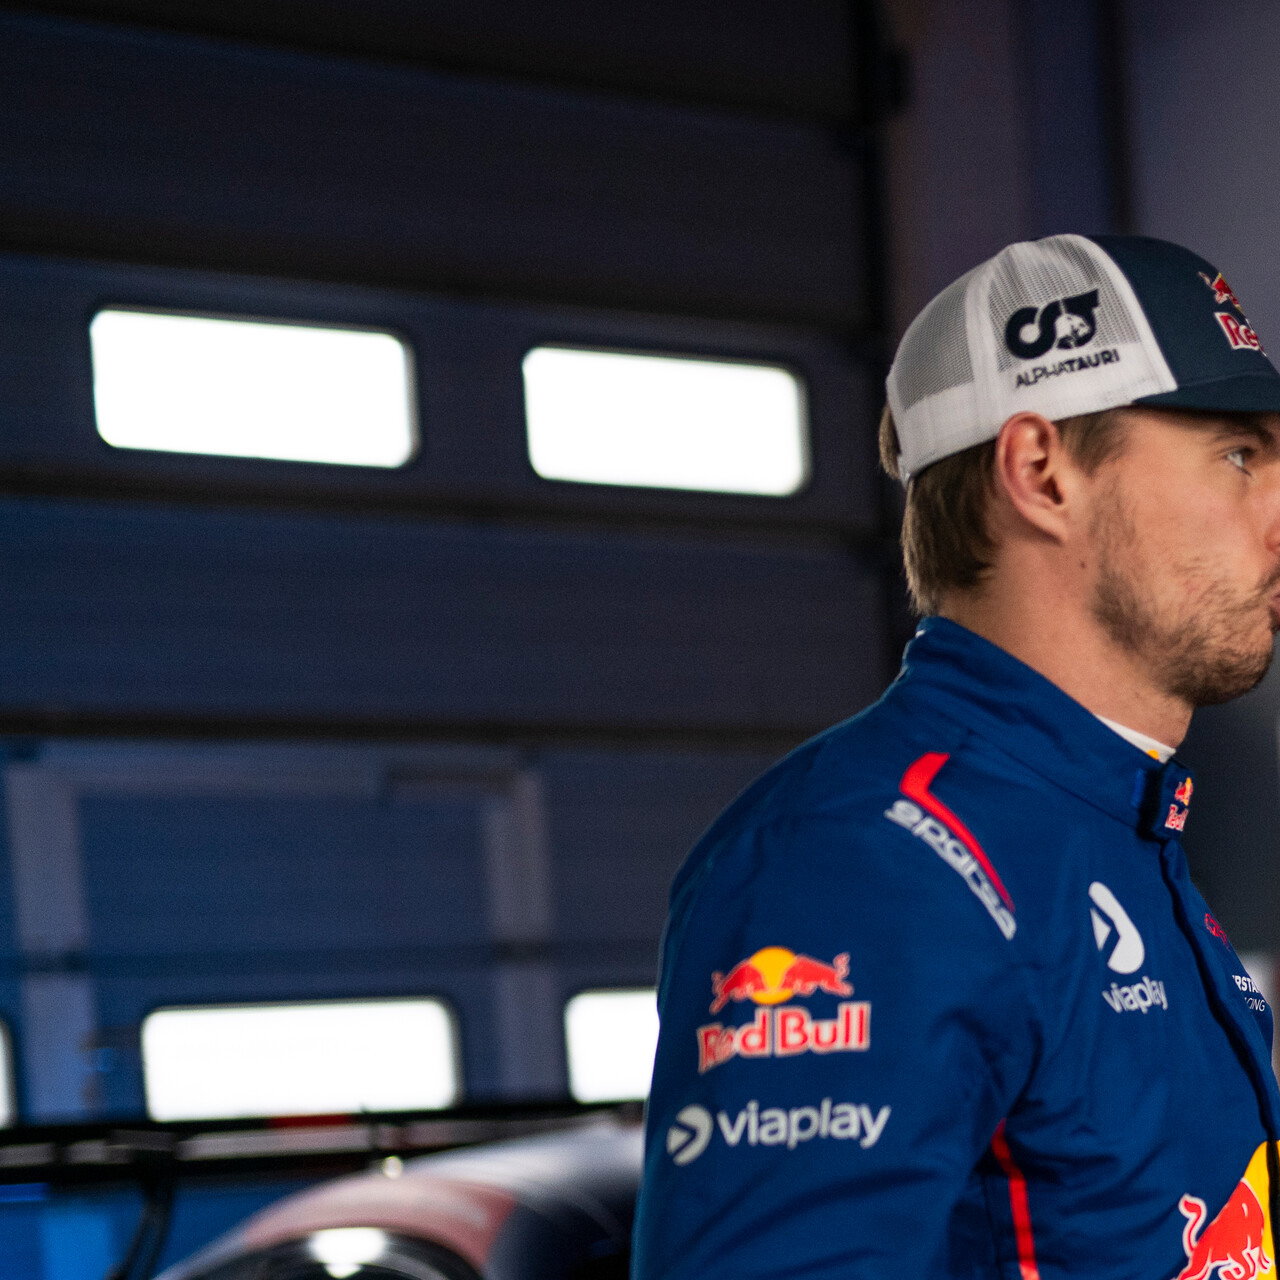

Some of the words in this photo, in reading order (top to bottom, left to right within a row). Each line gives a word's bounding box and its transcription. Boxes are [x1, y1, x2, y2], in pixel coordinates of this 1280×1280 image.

[1213, 311, 1266, 357] Re
[1015, 349, 1120, 388] ALPHATAURI
[1102, 976, 1168, 1014] viaplay
[773, 1001, 872, 1057] Bull
[716, 1097, 892, 1150] viaplay
